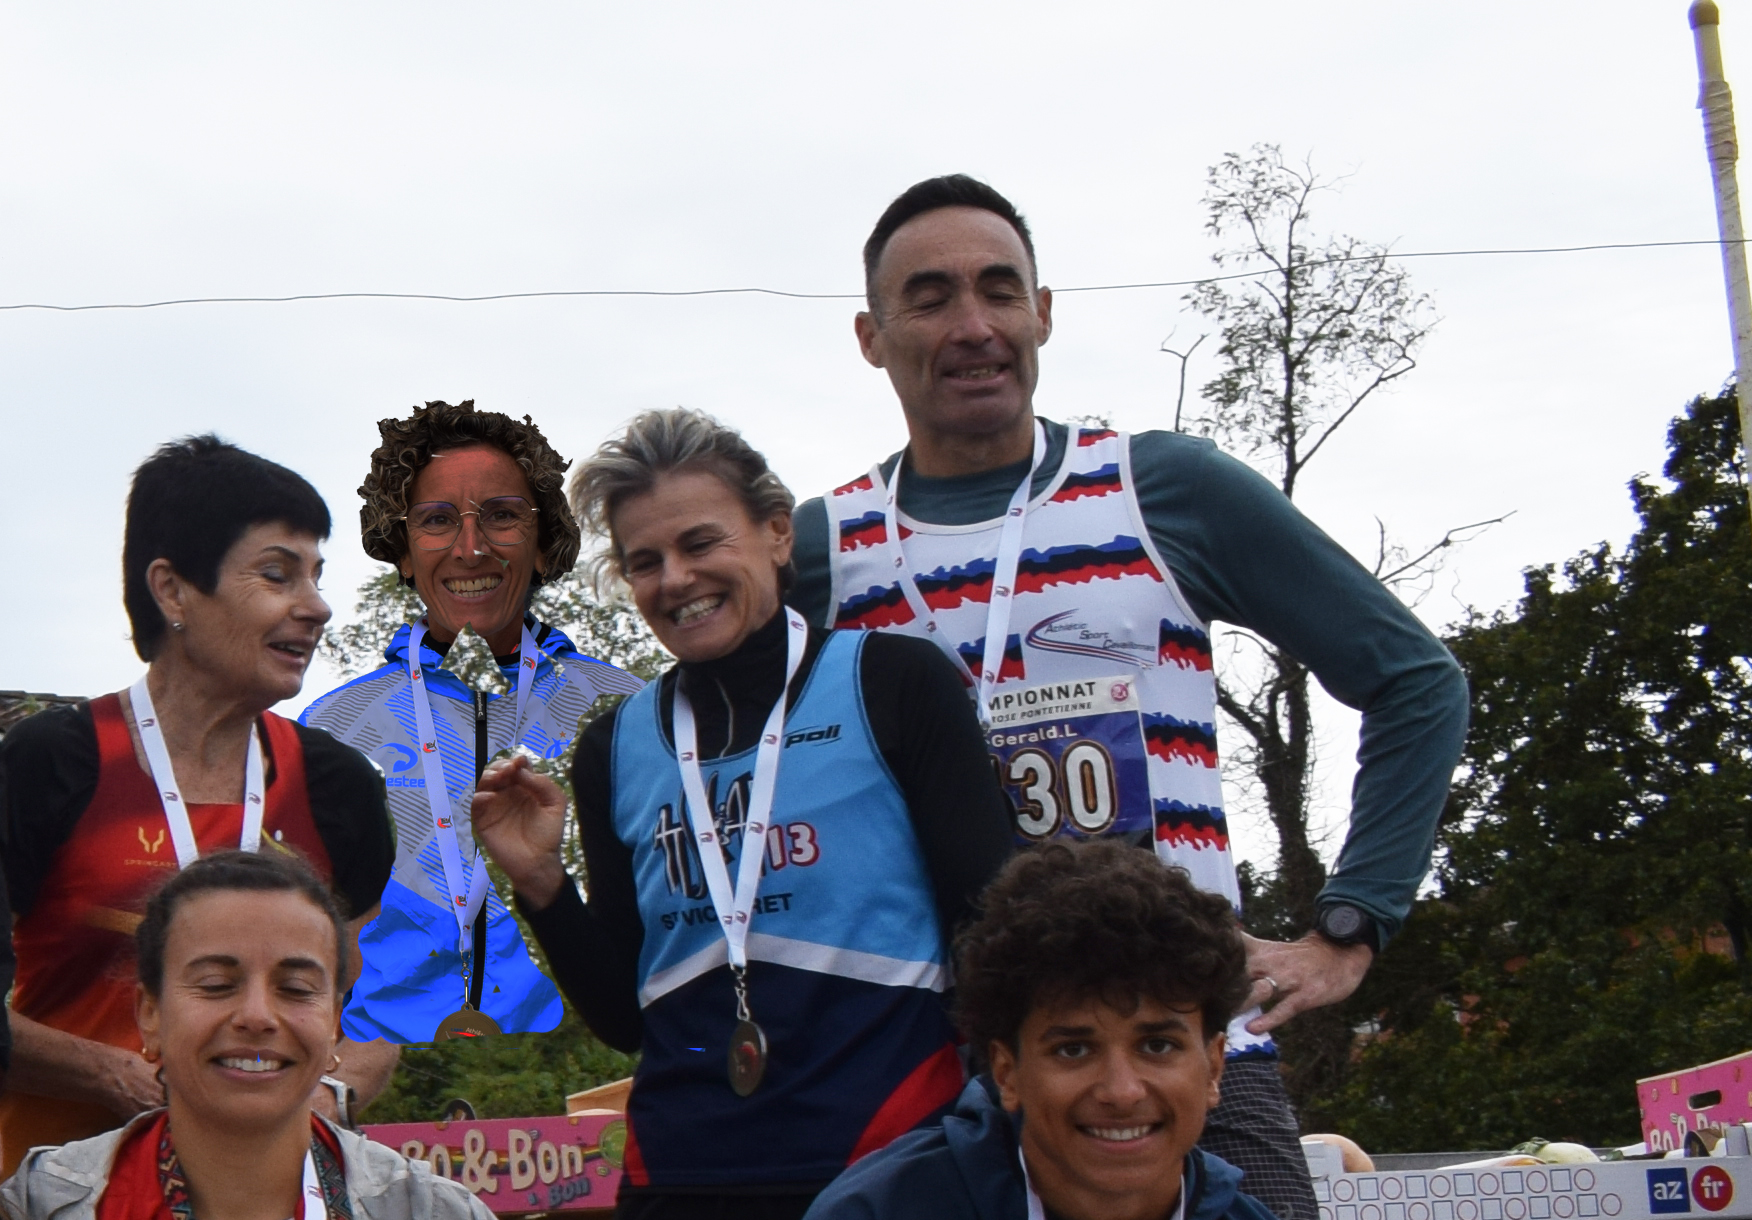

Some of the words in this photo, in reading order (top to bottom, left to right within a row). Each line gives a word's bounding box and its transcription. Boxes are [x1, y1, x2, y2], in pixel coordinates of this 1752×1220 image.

[1020, 701, 1093, 720] PONTETIENNE
[990, 723, 1078, 748] Gerald.L
[990, 739, 1118, 842] 30
[767, 822, 821, 871] 13
[508, 1129, 585, 1191] Bon
[1653, 1180, 1685, 1200] az
[1701, 1176, 1724, 1198] fr
